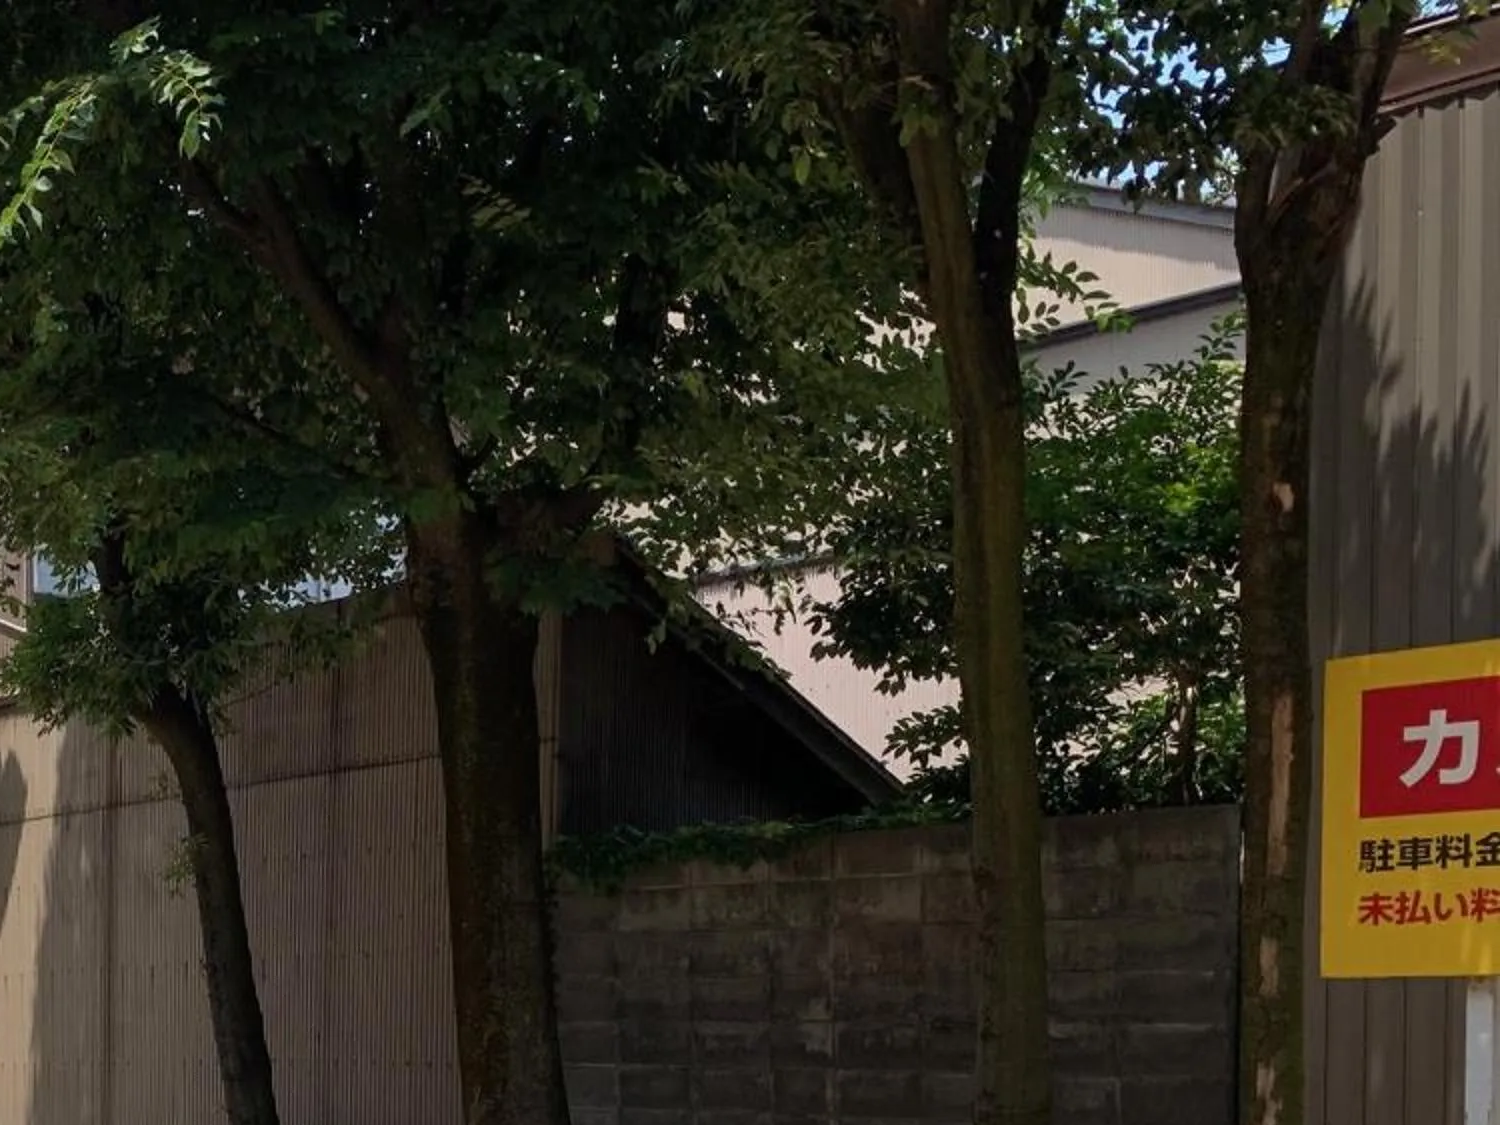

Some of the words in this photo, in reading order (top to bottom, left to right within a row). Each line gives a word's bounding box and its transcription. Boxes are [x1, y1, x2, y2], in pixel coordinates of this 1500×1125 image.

[1398, 708, 1500, 789] カ
[1357, 833, 1500, 873] 駐車料金
[1357, 887, 1500, 926] 未払い料
